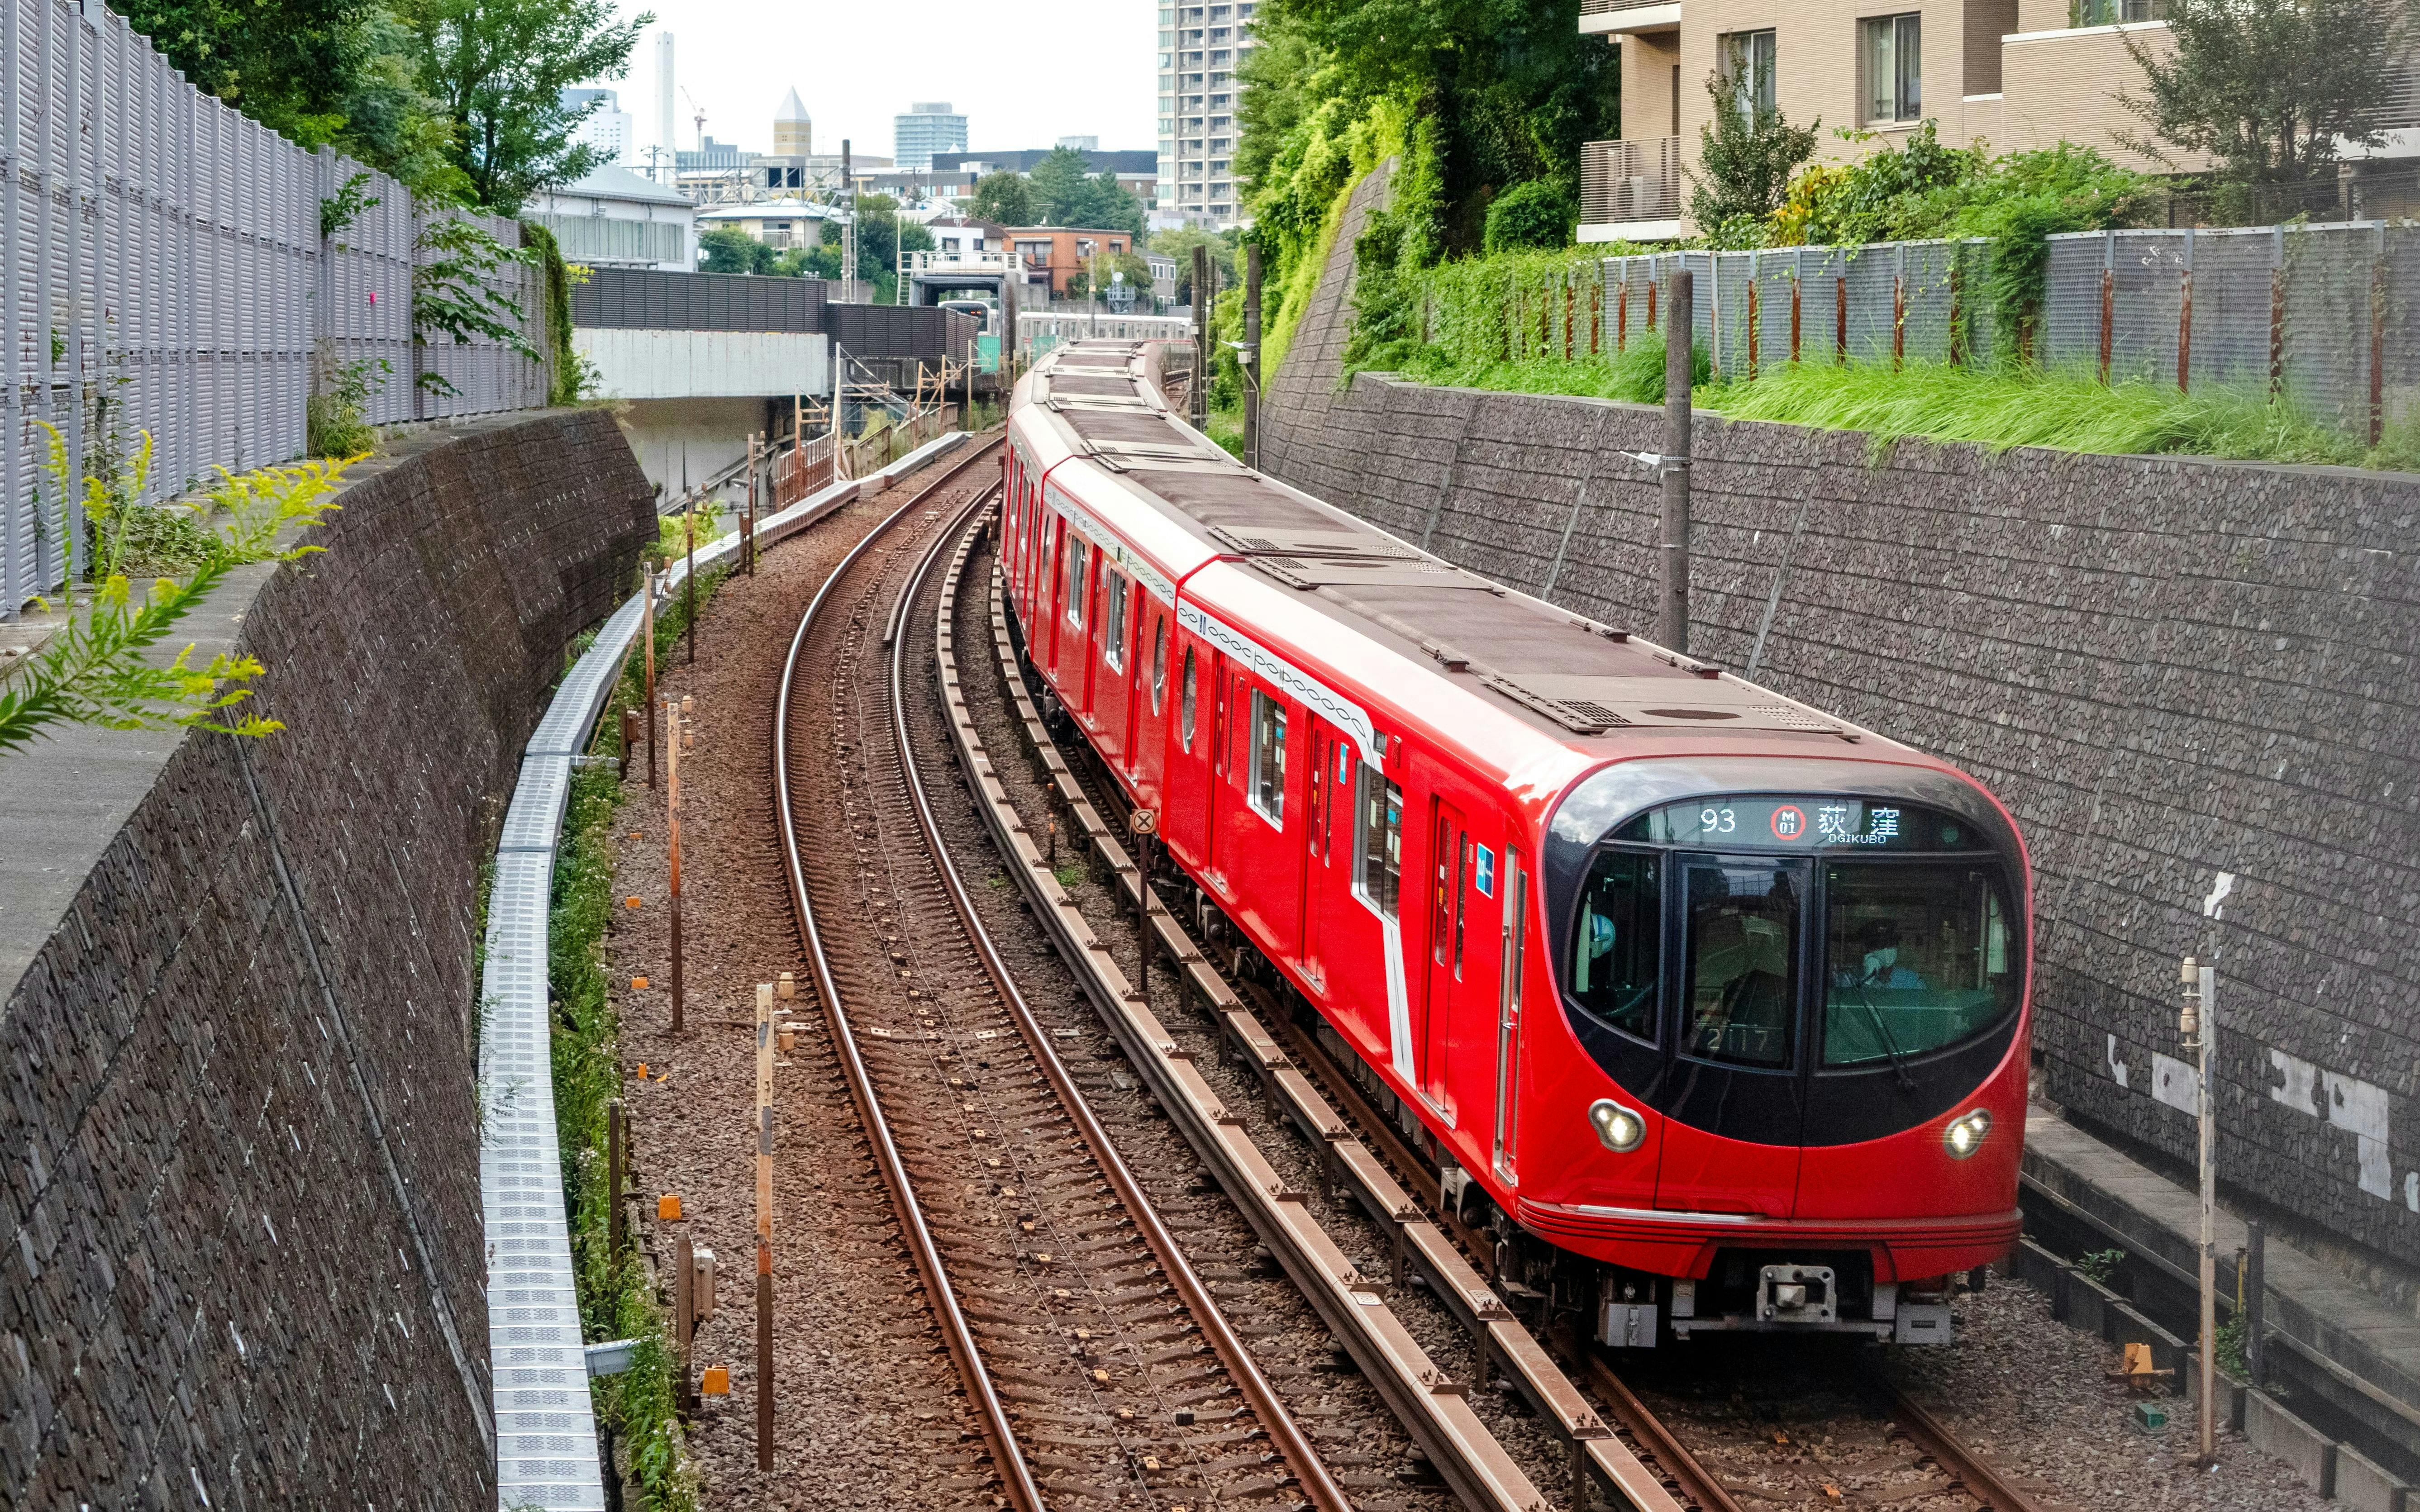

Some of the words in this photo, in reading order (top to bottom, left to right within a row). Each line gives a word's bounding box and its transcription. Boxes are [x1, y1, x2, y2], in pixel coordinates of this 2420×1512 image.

[1701, 809, 1735, 832] 93
[1782, 811, 1795, 821] M
[1818, 806, 1900, 836] 荻窪
[1779, 822, 1796, 833] 01
[1828, 833, 1886, 844] OGIKUBO
[1707, 1028, 1767, 1052] 2117
